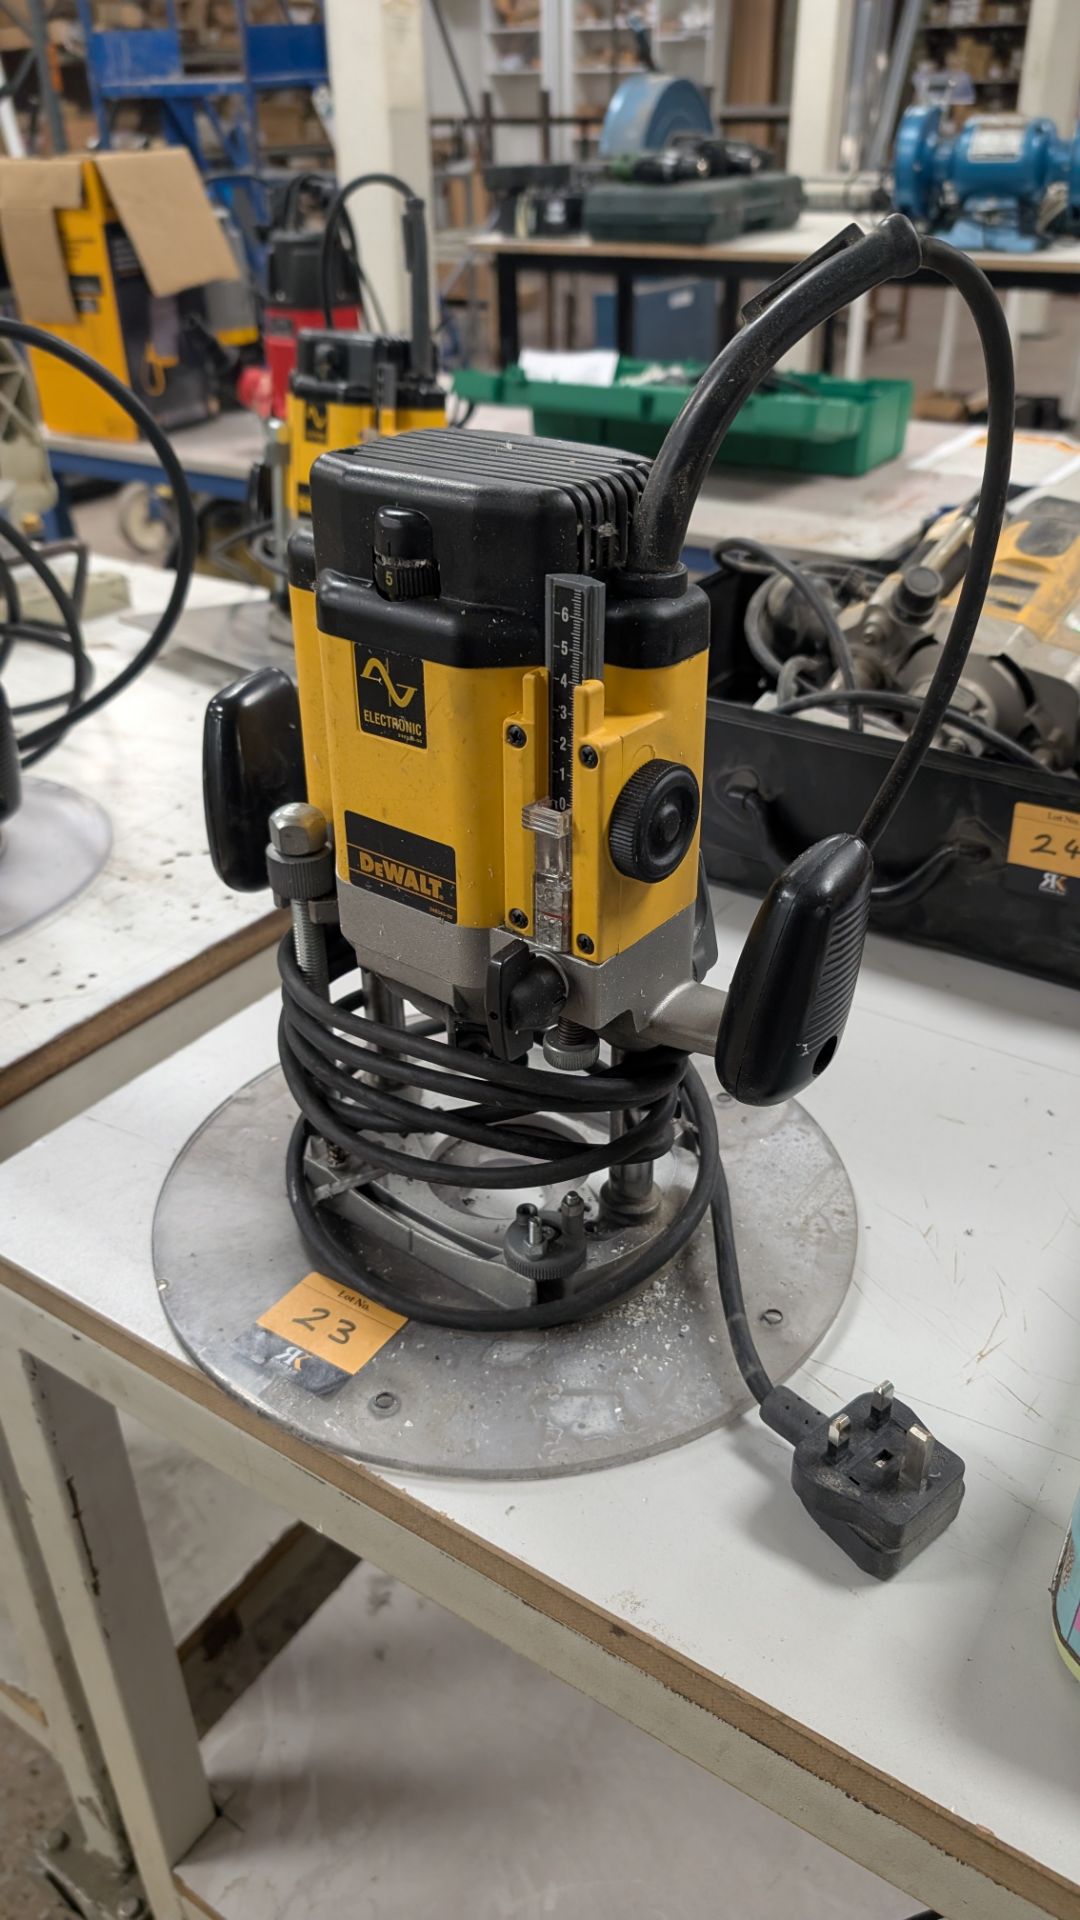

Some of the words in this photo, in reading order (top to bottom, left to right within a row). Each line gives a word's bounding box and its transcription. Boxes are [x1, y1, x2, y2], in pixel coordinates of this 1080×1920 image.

[385, 571, 393, 586] 5
[561, 606, 569, 622] 6
[561, 640, 568, 655] 5
[560, 673, 568, 688] 4
[560, 705, 567, 720] 3
[363, 708, 422, 736] ELECTRONIC
[559, 736, 567, 752] 2
[559, 767, 565, 781] 1
[1029, 833, 1080, 860] 24
[338, 1290, 355, 1302] Lot
[291, 1307, 358, 1345] 23
